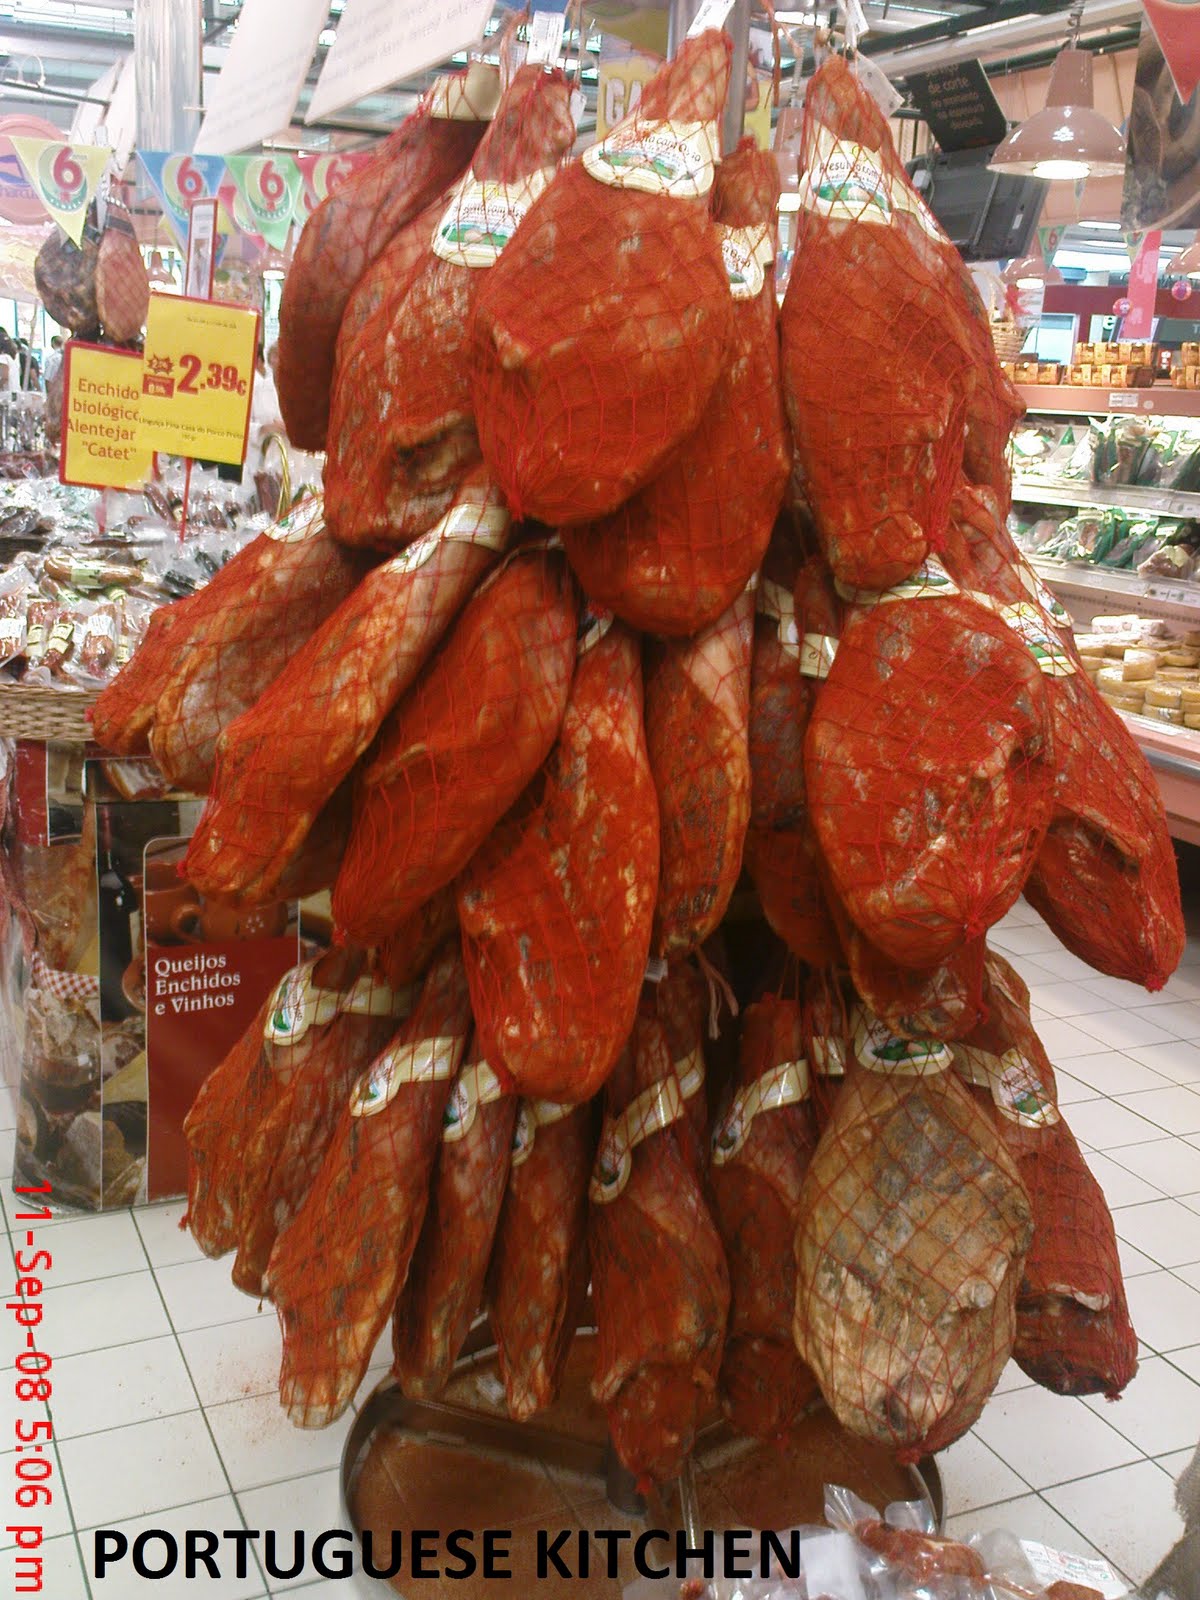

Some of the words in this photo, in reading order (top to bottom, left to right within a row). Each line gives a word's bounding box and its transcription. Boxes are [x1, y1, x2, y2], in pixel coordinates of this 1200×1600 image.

[54, 146, 83, 190] 6
[177, 156, 203, 196] 6
[260, 160, 285, 200] 6
[154, 953, 227, 977] Queijos
[155, 972, 241, 996] Enchidos
[154, 1002, 166, 1015] e
[171, 992, 235, 1013] Vinhos
